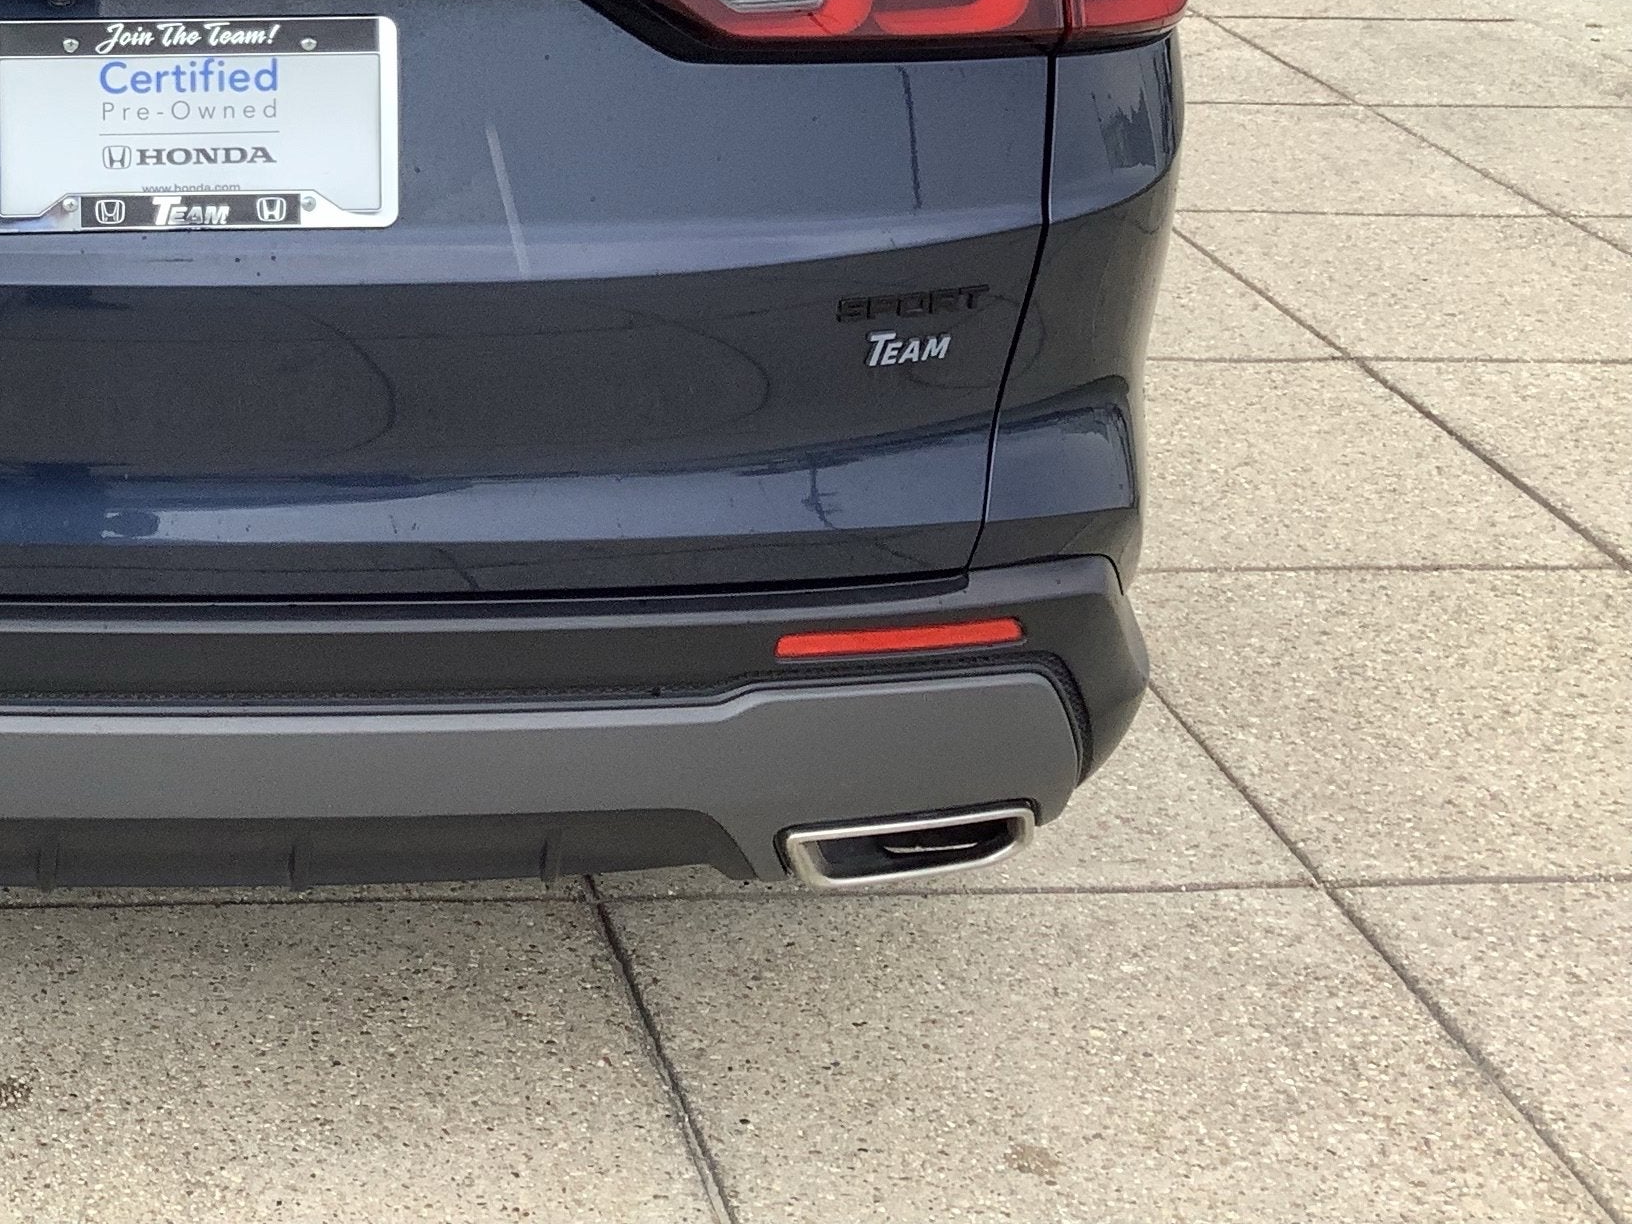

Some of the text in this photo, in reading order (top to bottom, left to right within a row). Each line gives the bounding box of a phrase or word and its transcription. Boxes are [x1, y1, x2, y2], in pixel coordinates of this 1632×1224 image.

[95, 22, 280, 54] Join The Team!
[99, 56, 278, 94] Certified
[102, 98, 277, 121] Pre-Owned
[136, 147, 277, 166] HONDA
[836, 284, 990, 323] SPORT
